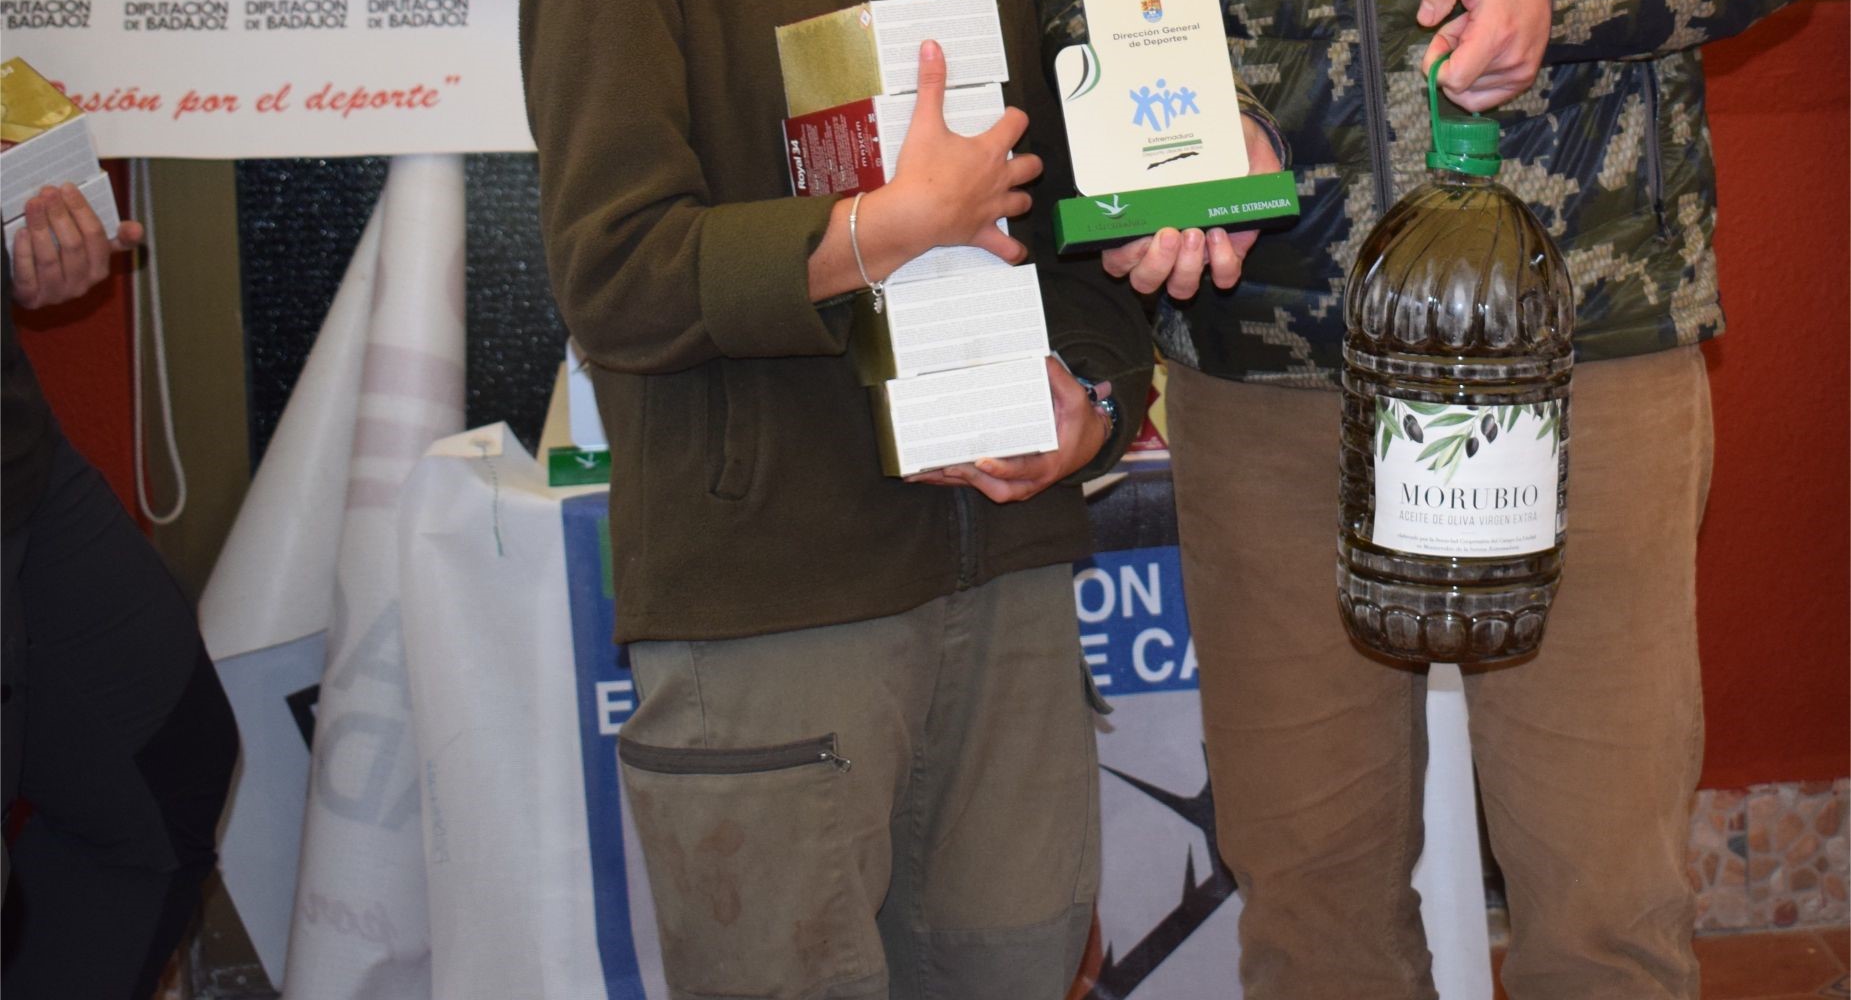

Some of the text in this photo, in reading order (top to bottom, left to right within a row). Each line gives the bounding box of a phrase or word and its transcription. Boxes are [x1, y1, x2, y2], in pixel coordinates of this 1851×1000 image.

[7, 14, 91, 30] BADAJOZ
[124, 14, 228, 31] DE BADAJOZ
[245, 13, 347, 30] DE BADAJOZ
[368, 11, 469, 28] DE BADAJOZ
[1162, 23, 1200, 34] General
[1128, 35, 1188, 48] de Deportes
[173, 91, 239, 119] por
[256, 83, 292, 112] el
[793, 156, 807, 190] Royal
[1208, 198, 1292, 218] JUNTA DE EXTREMADURA
[1400, 482, 1538, 510] MORUBIO
[1399, 510, 1538, 526] ACEITE DE OLIVA VIRGEN EXTRA
